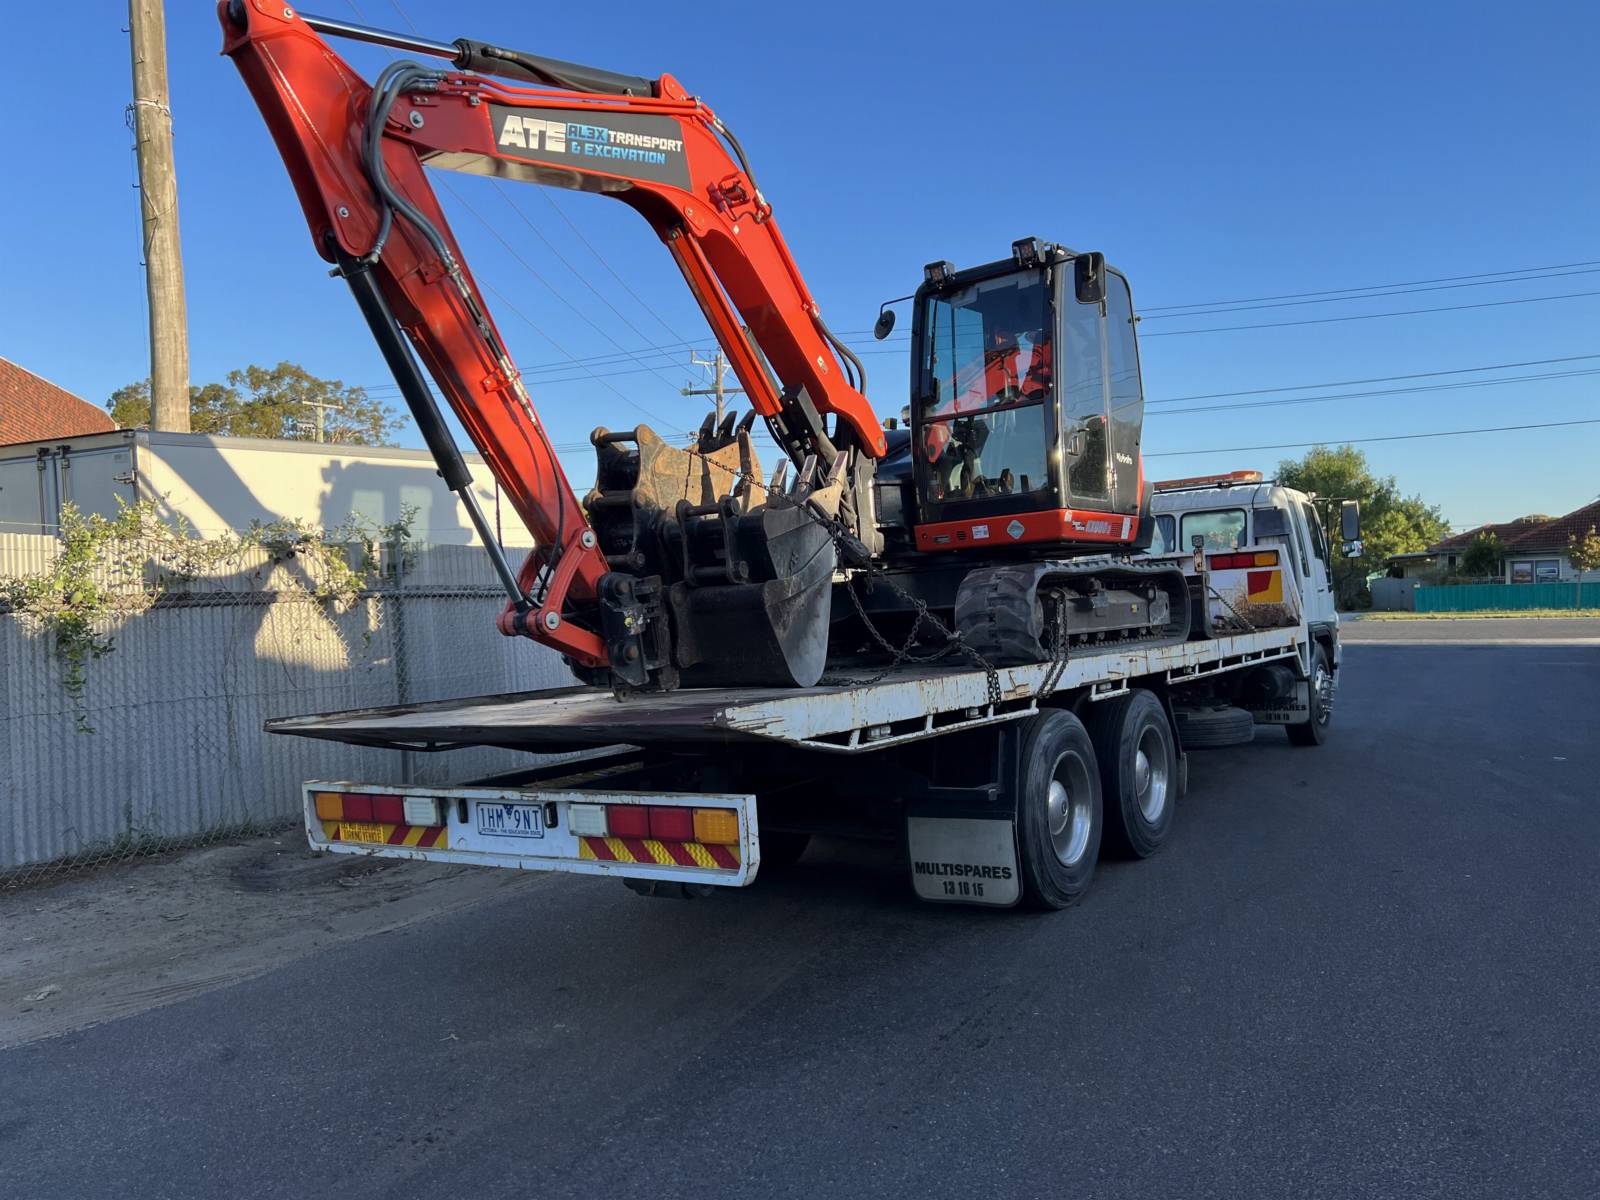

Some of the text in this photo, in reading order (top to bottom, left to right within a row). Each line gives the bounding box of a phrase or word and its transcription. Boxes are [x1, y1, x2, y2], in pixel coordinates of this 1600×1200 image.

[498, 115, 566, 153] ATE
[608, 130, 683, 152] TRANSPORT
[571, 142, 666, 164] & EXCAVATION
[480, 807, 539, 831] 1HM 9NT
[914, 861, 1013, 880] MULTISPARES
